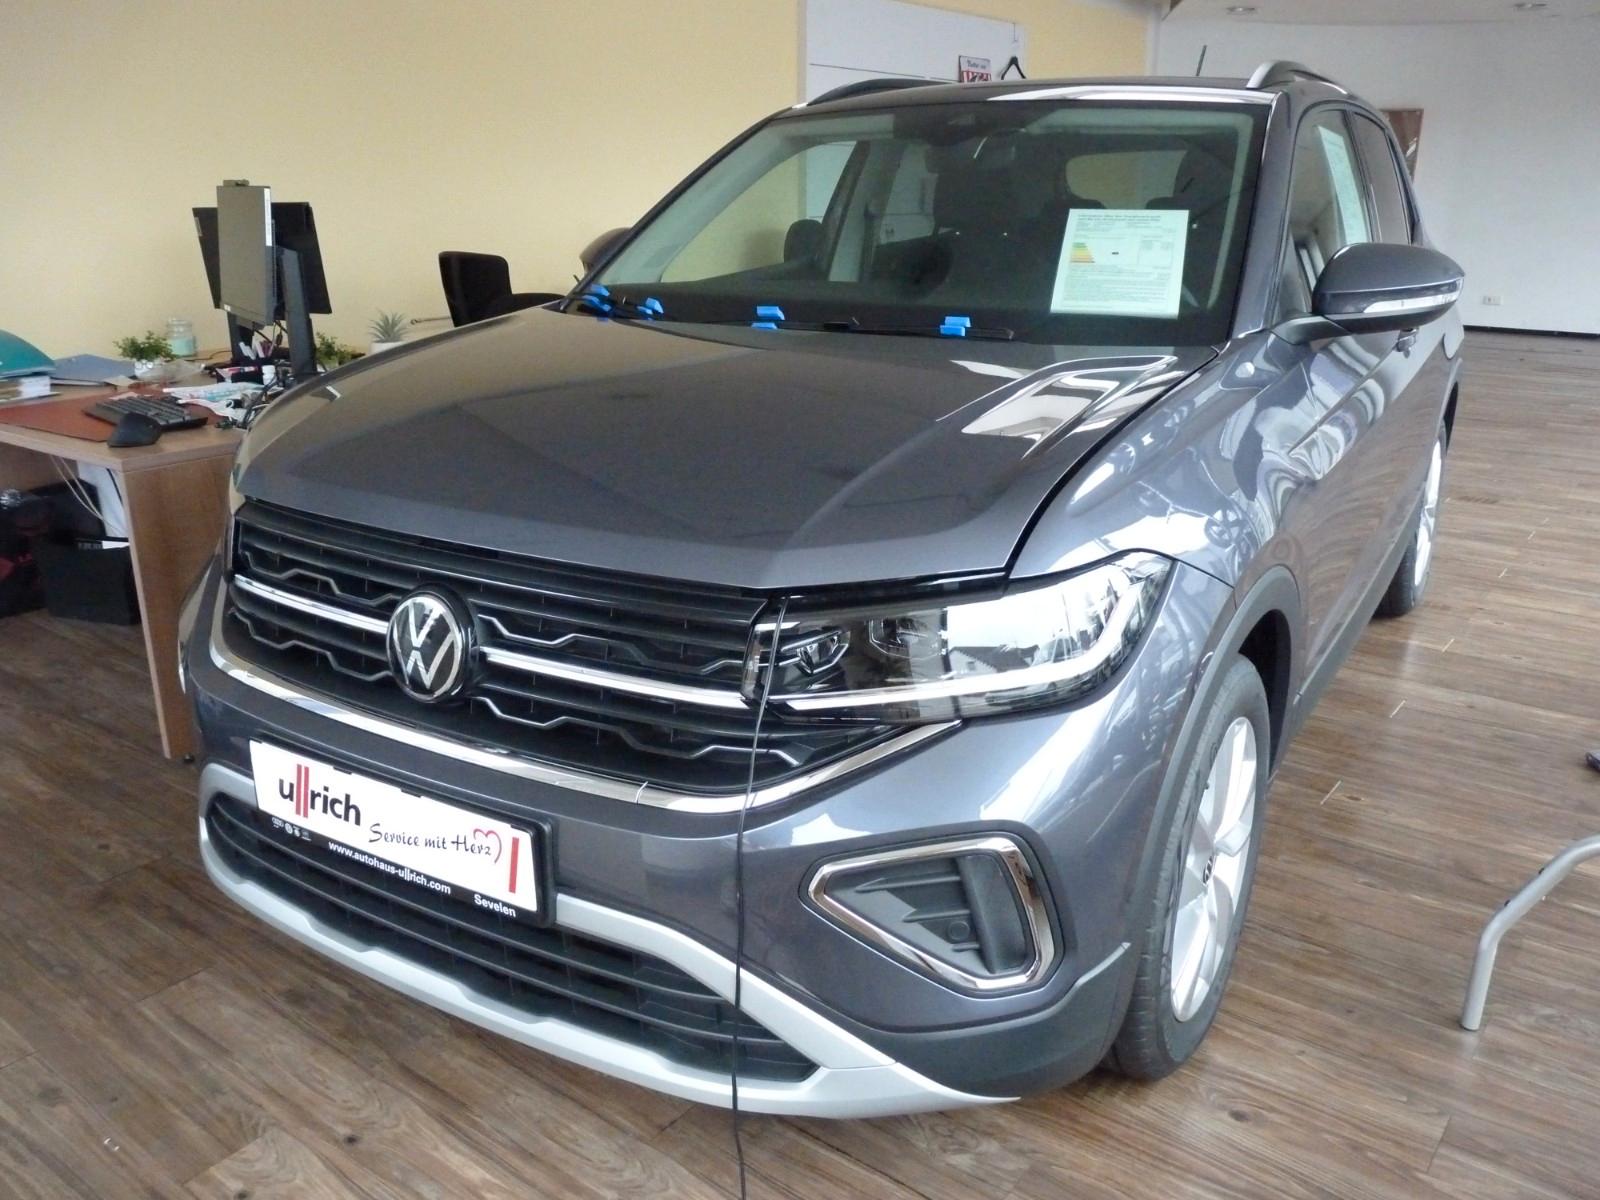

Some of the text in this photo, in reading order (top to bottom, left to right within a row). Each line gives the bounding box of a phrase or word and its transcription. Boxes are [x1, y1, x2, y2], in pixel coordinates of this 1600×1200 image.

[278, 763, 361, 826] ullrich
[368, 822, 492, 857] Service mit Herz
[328, 840, 452, 896] www.autohaus-ullrich.com
[473, 893, 517, 918] Sevelen
